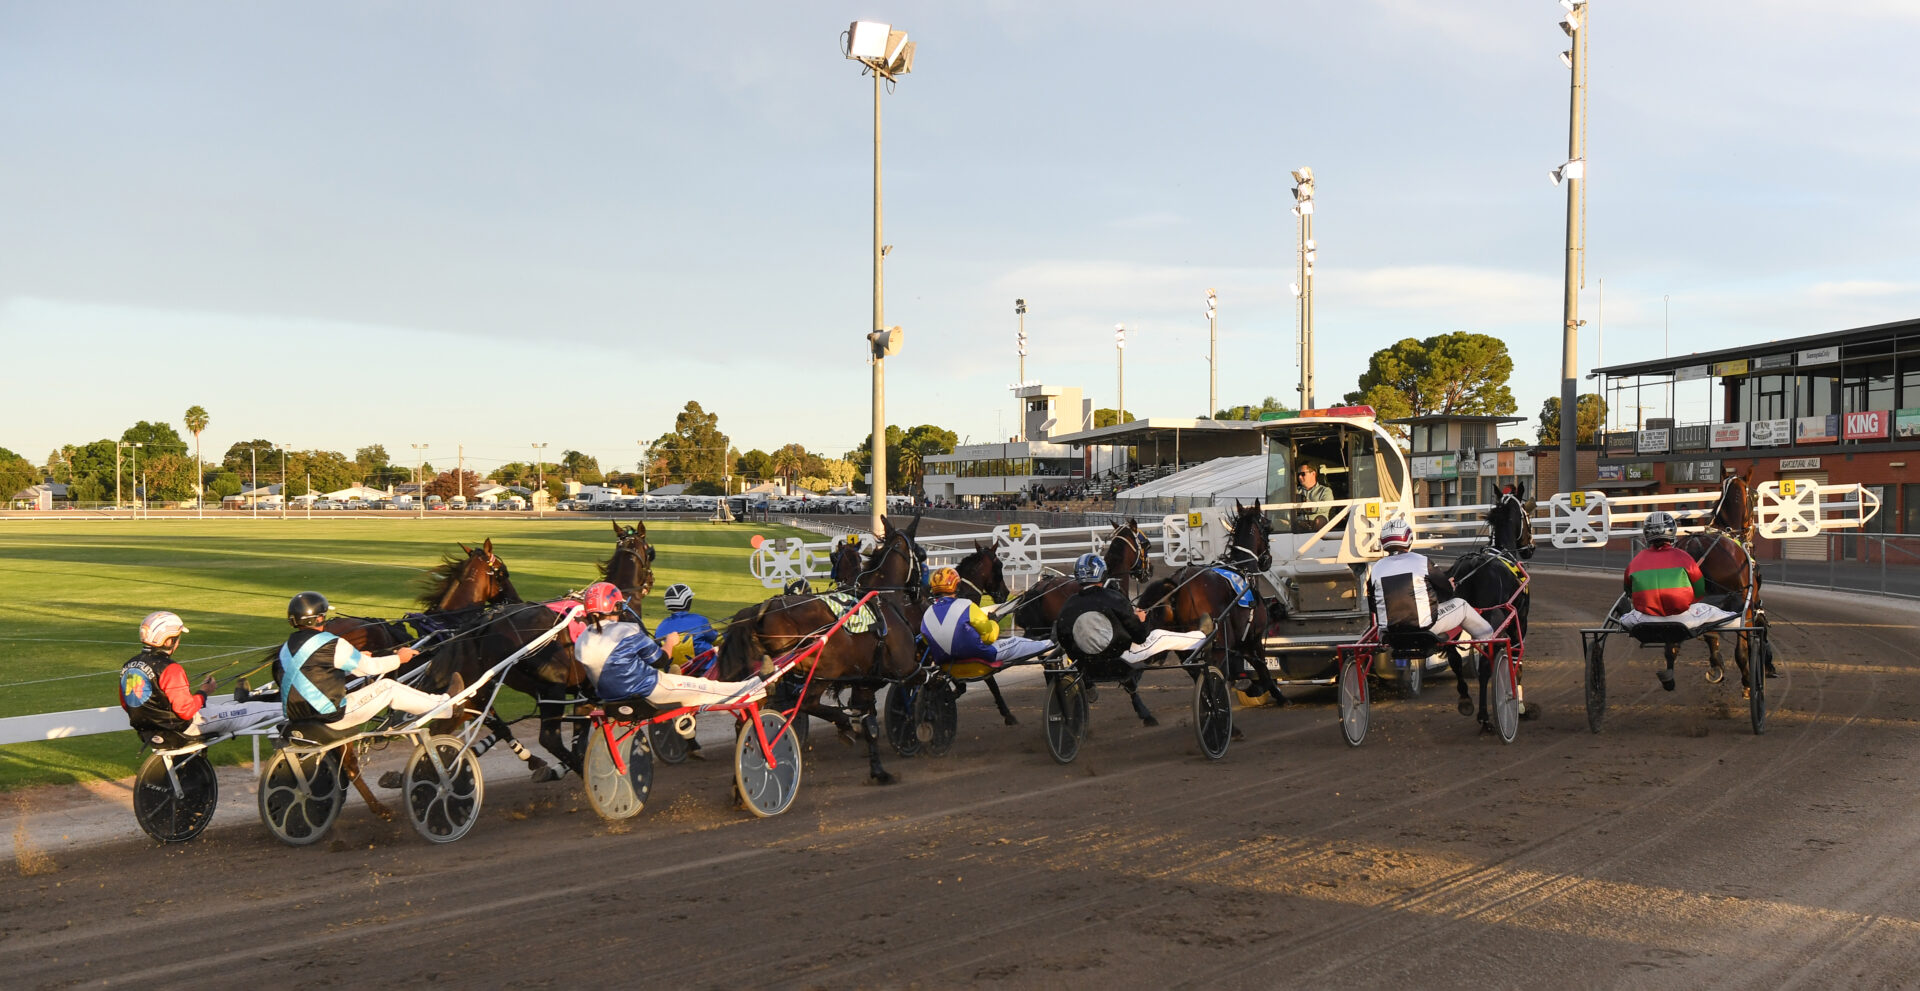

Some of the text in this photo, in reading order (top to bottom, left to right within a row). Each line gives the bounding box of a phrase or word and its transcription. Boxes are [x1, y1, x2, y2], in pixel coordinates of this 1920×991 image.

[1847, 413, 1879, 434] KING
[1784, 483, 1790, 493] 6
[1575, 494, 1581, 505] 5
[1370, 505, 1376, 515] 4
[1192, 515, 1198, 525] 3
[1013, 526, 1019, 536] 2
[136, 660, 155, 680] FRUITS
[218, 711, 228, 719] ALEX
